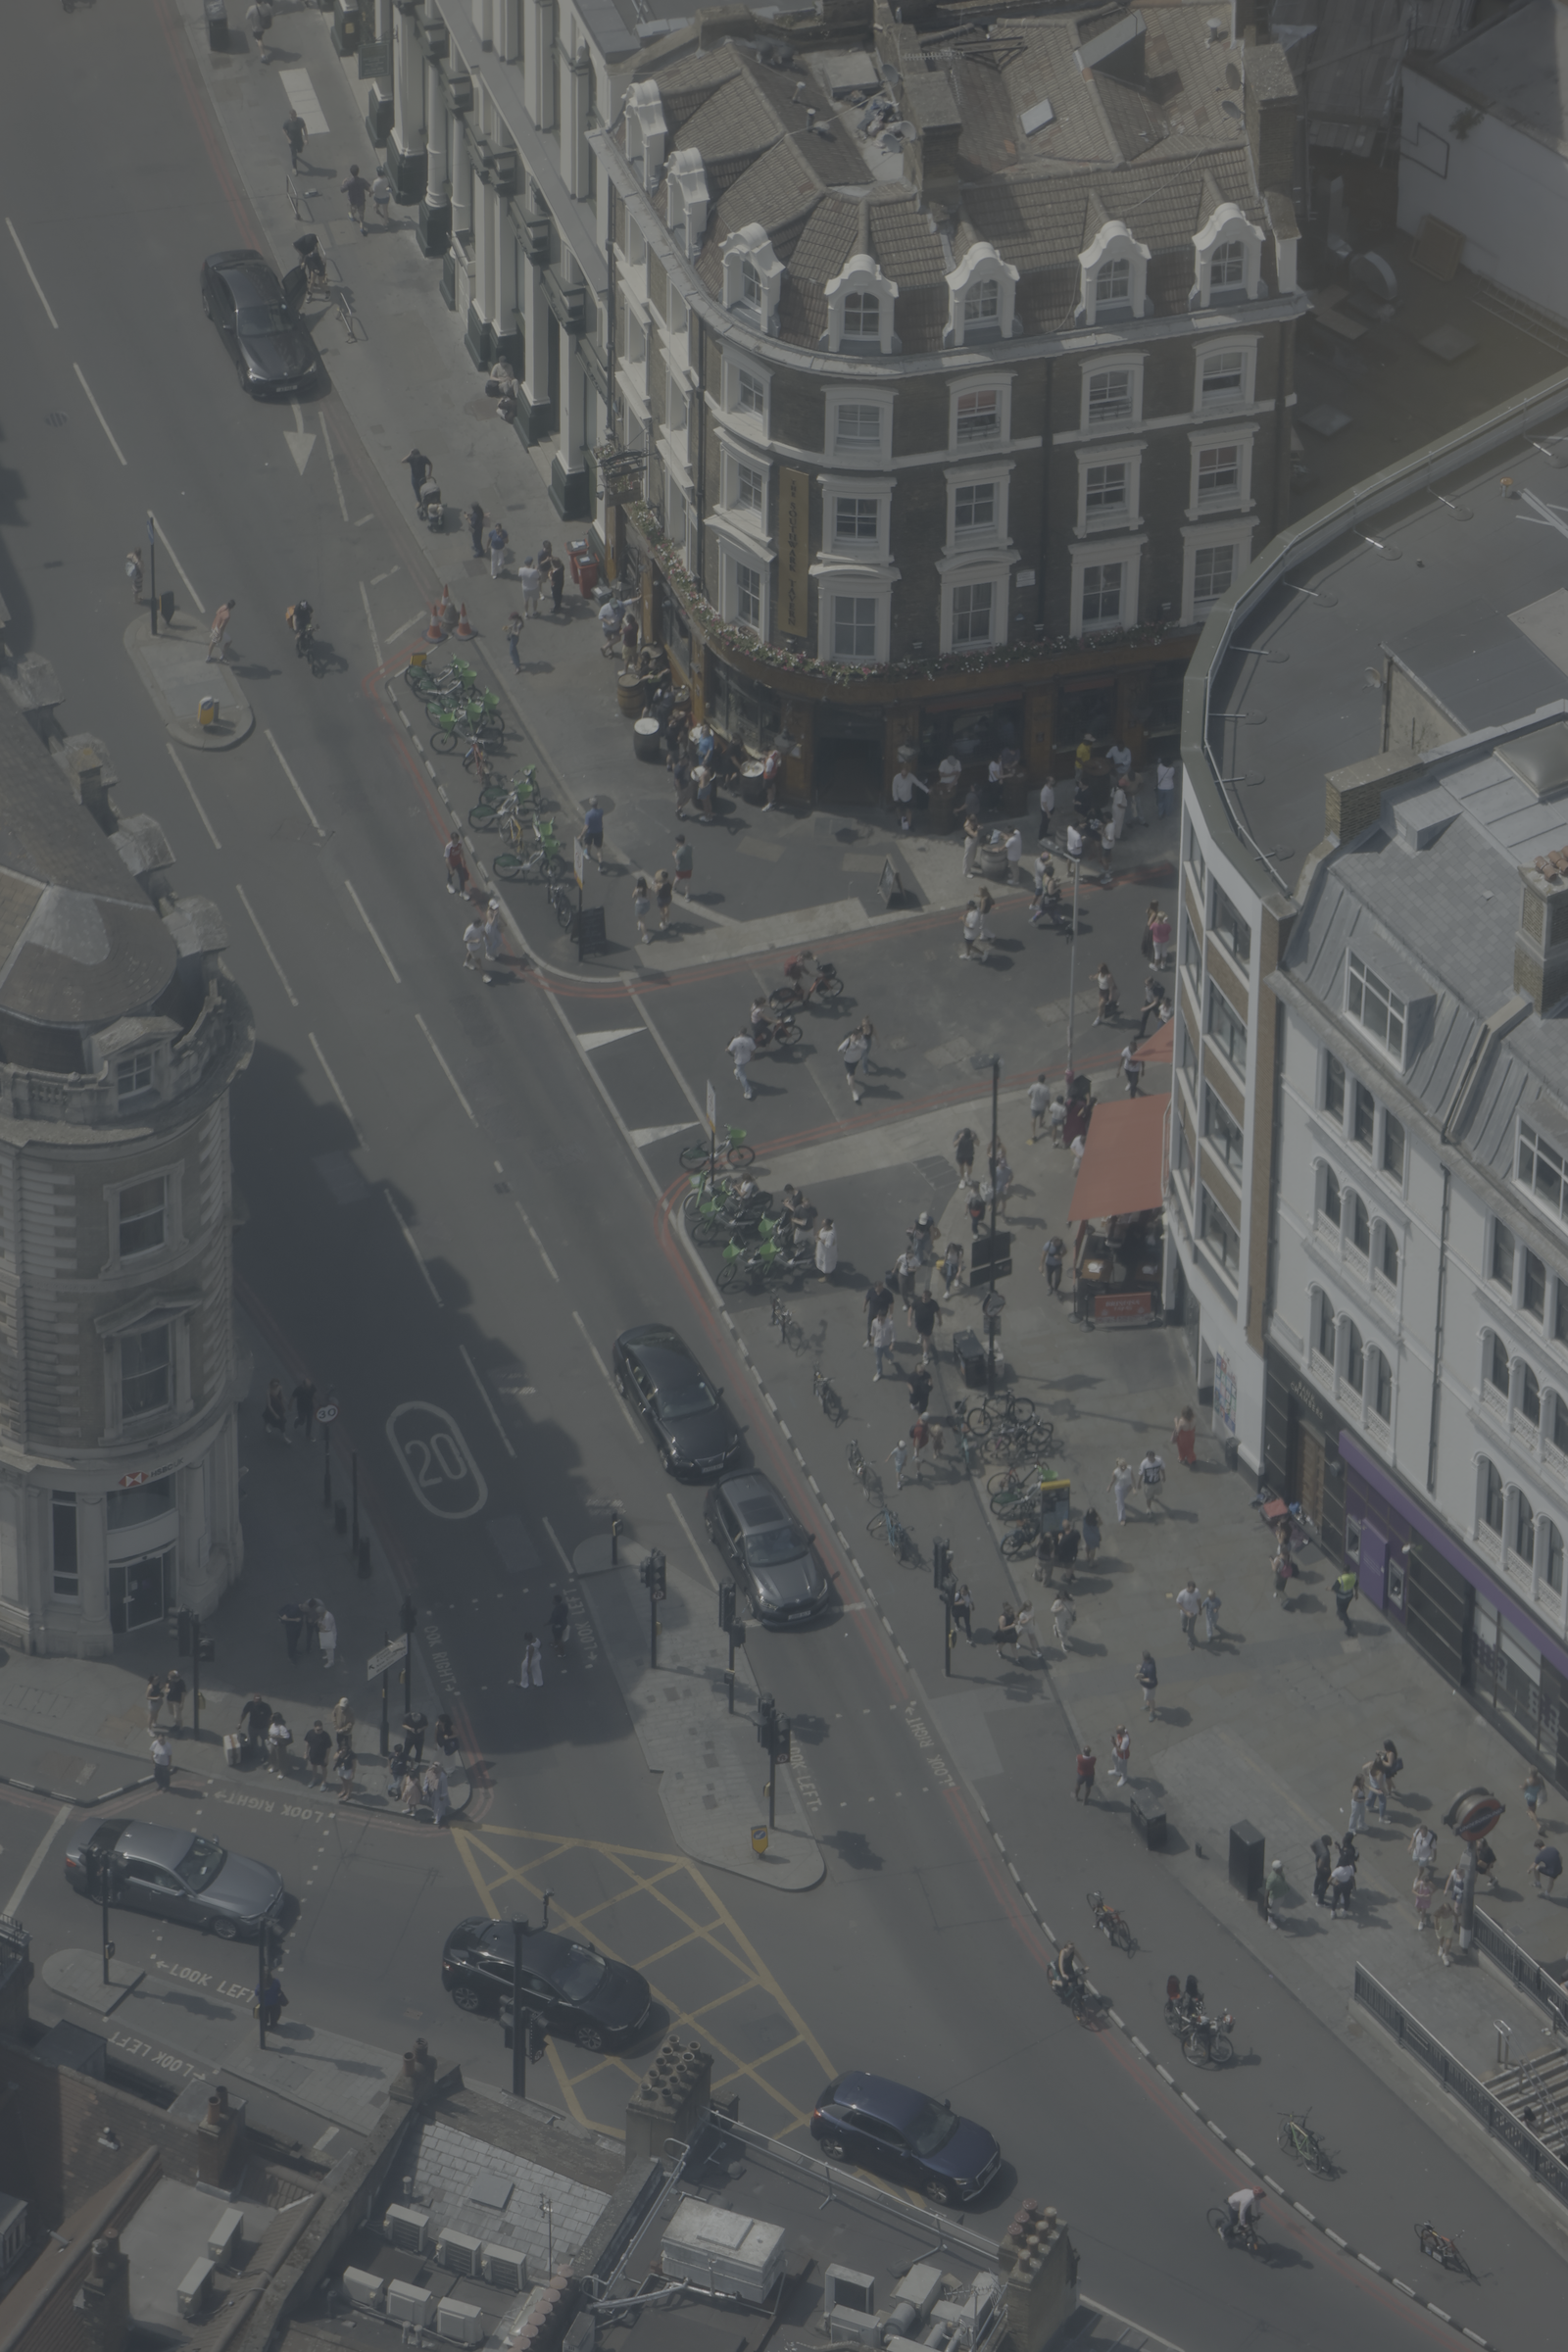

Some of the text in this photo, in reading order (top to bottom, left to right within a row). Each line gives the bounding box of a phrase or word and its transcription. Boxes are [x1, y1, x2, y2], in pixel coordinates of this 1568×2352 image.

[788, 502, 798, 573] SOUTHWARK
[788, 579, 797, 626] TAVERN
[318, 1407, 336, 1419] 30
[150, 1457, 184, 1477] HSBC UK
[405, 1433, 467, 1488] 20
[563, 1589, 598, 1650] LOOK LEFT
[432, 1651, 457, 1684] RIGHT
[906, 1717, 954, 1785] LOOK RIGHT
[224, 1792, 324, 1824] LOOK RIGHT
[796, 1775, 822, 1806] LEFT
[1459, 1807, 1503, 1833] UNDERGROUND
[170, 1963, 256, 2003] LOOK LEFT
[107, 2031, 195, 2078] LOOK LEFT
